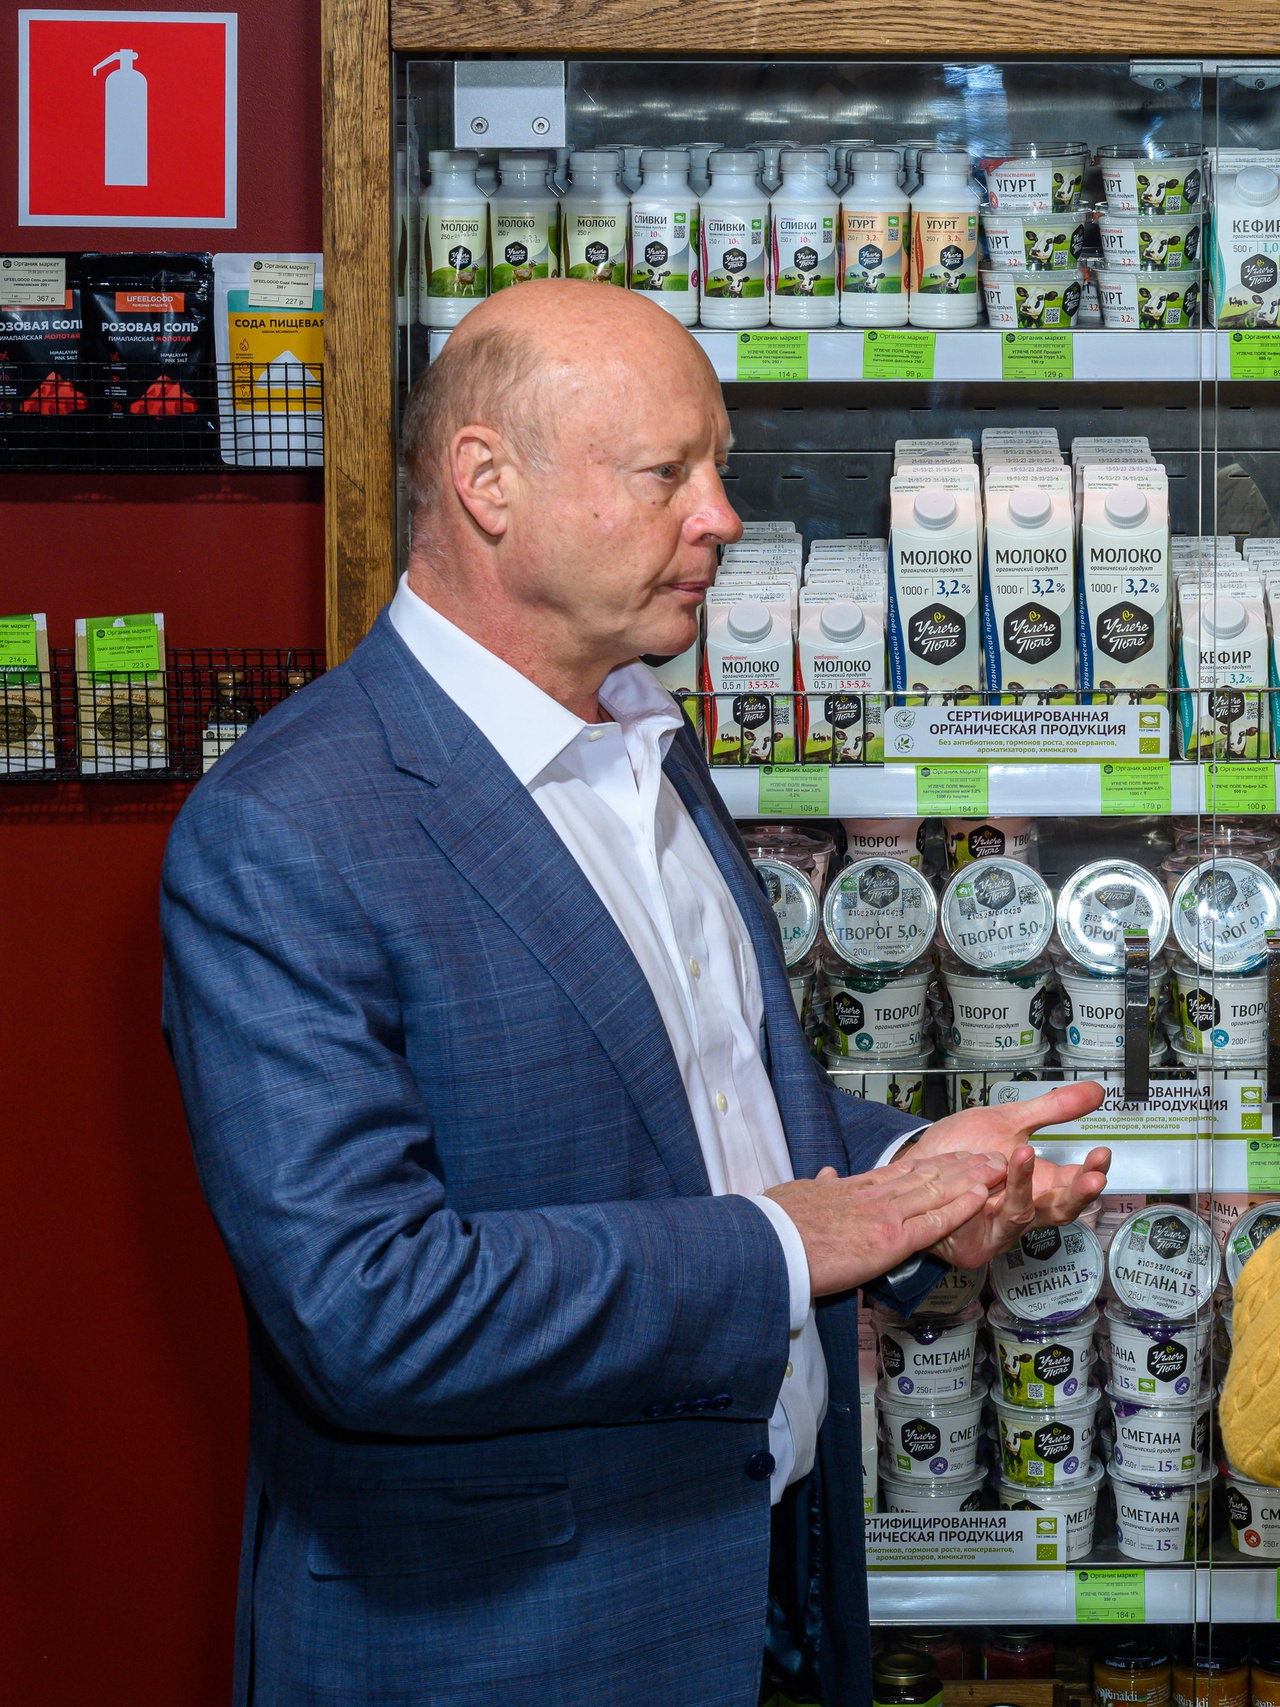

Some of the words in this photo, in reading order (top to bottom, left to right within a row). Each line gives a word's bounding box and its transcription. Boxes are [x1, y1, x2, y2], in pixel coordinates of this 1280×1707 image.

[996, 180, 1036, 193] УГУРТ
[497, 219, 535, 229] МОЛОКО
[577, 219, 616, 229] МОЛОКО
[634, 214, 667, 225] СЛИВКИ
[780, 221, 817, 231] СЛИВКИ
[848, 219, 875, 229] УГУРТ
[926, 220, 957, 229] УГУРТ
[440, 222, 479, 233] МОЛОКО
[708, 222, 745, 232] СЛИВКИ
[1233, 245, 1246, 253] 500
[126, 295, 173, 303] UFEELGOOD
[102, 322, 160, 332] РОЗОВАЯ
[164, 322, 198, 332] СОЛЬ
[234, 318, 266, 329] СОДА
[270, 318, 324, 330] ПИЩЕВАЯ
[752, 334, 778, 342] Органик
[900, 550, 972, 565] МОЛОКО
[995, 549, 1067, 565] МОЛОКО
[1090, 548, 1162, 563] МОЛОКО
[901, 585, 922, 595] 1000
[936, 580, 970, 597] 3,2%
[1031, 578, 1065, 596] 3,2%
[1125, 578, 1160, 595] 3,2%
[915, 621, 960, 635] Углече
[922, 638, 957, 654] Поле
[1200, 651, 1251, 664] КЕФИР
[722, 661, 779, 674] МОЛОКО
[814, 660, 871, 673] МОЛОКО
[722, 681, 734, 690] 0,5
[748, 680, 779, 689] 3,5-5,2%
[947, 711, 1109, 724] СЕРТИФИЦИРОВАННАЯ
[930, 724, 1036, 736] ОРГАНИЧЕСКАЯ
[1041, 724, 1126, 737] ПРОДУКЦИЯ
[953, 739, 1004, 747] антибиотиков,
[1042, 740, 1064, 748] роста,
[1247, 802, 1260, 810] 100
[852, 835, 900, 847] ТВОРОГ
[837, 925, 893, 941] ТВОРОГ
[959, 926, 1015, 947] ТВОРОГ
[874, 1004, 920, 1020] ТВОРОГ
[959, 1005, 1009, 1020] ТВОРОГ
[1115, 1266, 1177, 1293] СМЕТАНА
[1007, 1275, 1071, 1301] СМЕТАНА
[913, 1347, 970, 1366] СМЕТАНА
[1121, 1427, 1181, 1444] СМЕТАНА
[1157, 1460, 1178, 1472] 15%
[1121, 1505, 1180, 1523] СМЕТАНА
[940, 1531, 1023, 1543] ПРОДУКЦИЯ
[1156, 1539, 1178, 1551] 15%
